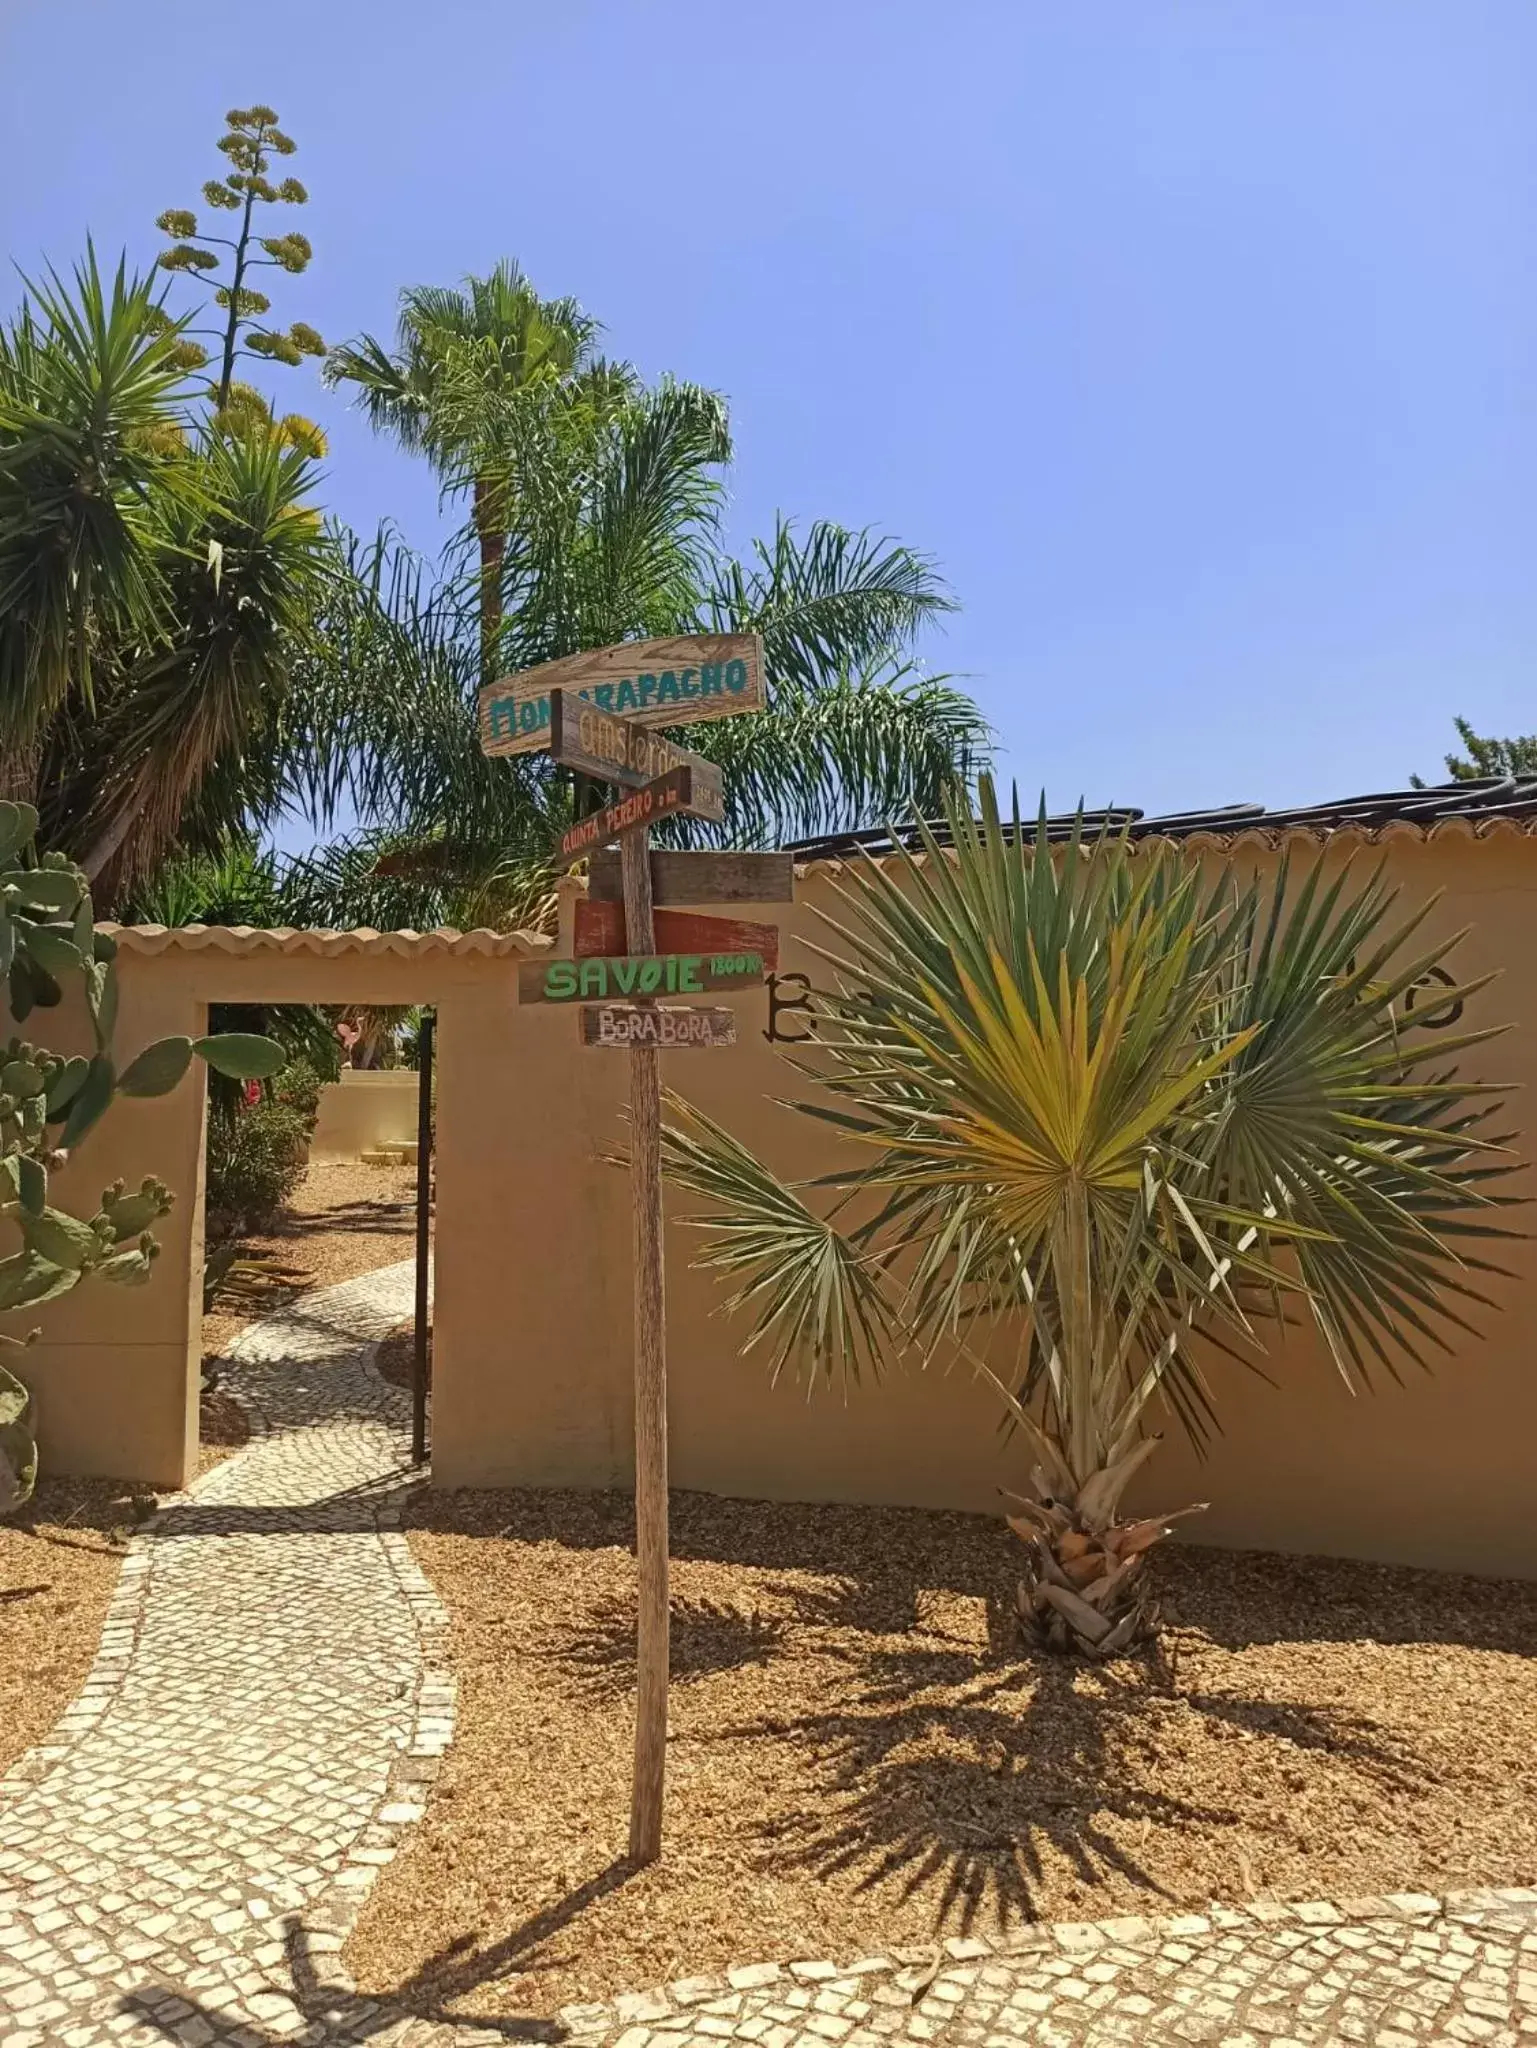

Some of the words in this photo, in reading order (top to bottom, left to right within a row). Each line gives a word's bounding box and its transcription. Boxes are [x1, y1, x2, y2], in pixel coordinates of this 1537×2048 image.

[562, 818, 600, 855] QUINTA
[543, 956, 704, 998] SAVOIE
[600, 1010, 658, 1042] BORA
[659, 1012, 713, 1043] BORA
